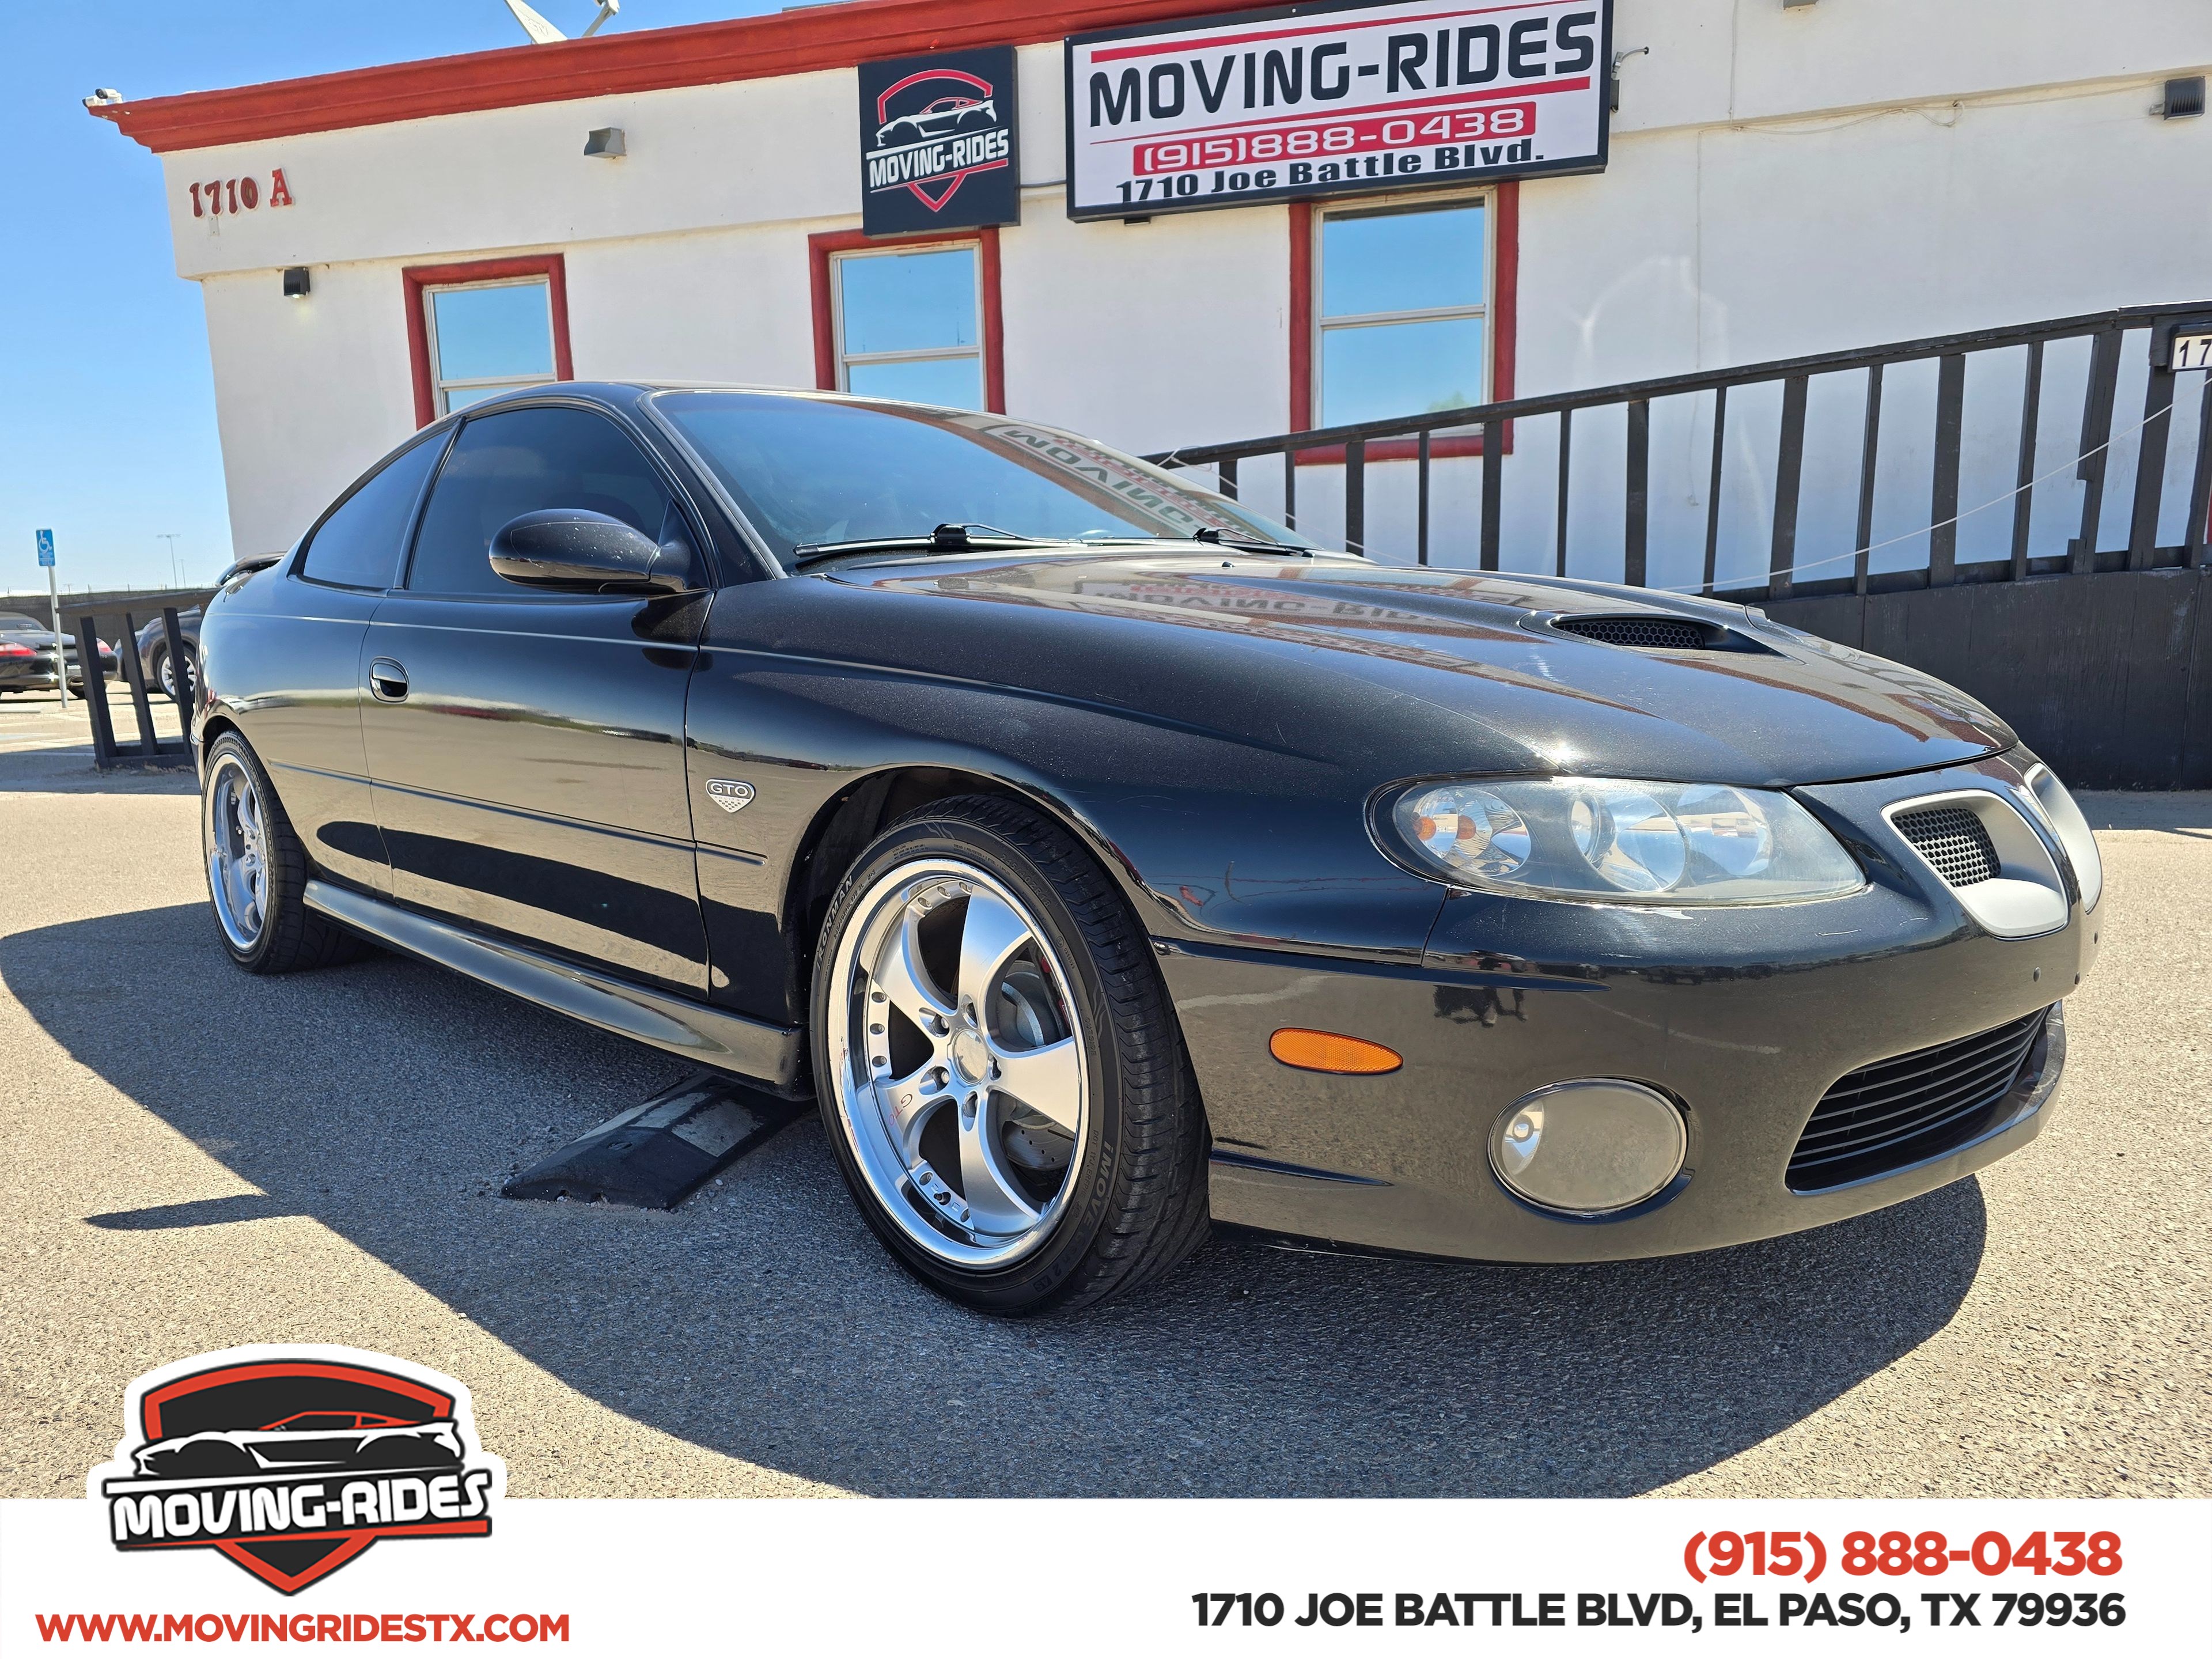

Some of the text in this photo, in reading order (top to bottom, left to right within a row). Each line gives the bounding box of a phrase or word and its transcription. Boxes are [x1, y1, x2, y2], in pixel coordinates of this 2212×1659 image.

[1090, 11, 1596, 127] MOVING-RIDES
[870, 128, 1008, 187] MOVING-RIDES
[1116, 138, 1544, 203] 1710 Joe Battle Blvd.
[1144, 108, 1524, 172] (915)888-0438
[190, 168, 293, 217] 1710 A
[710, 783, 748, 797] GTO
[817, 875, 853, 971] IRONMAN
[889, 1093, 913, 1126] GTO
